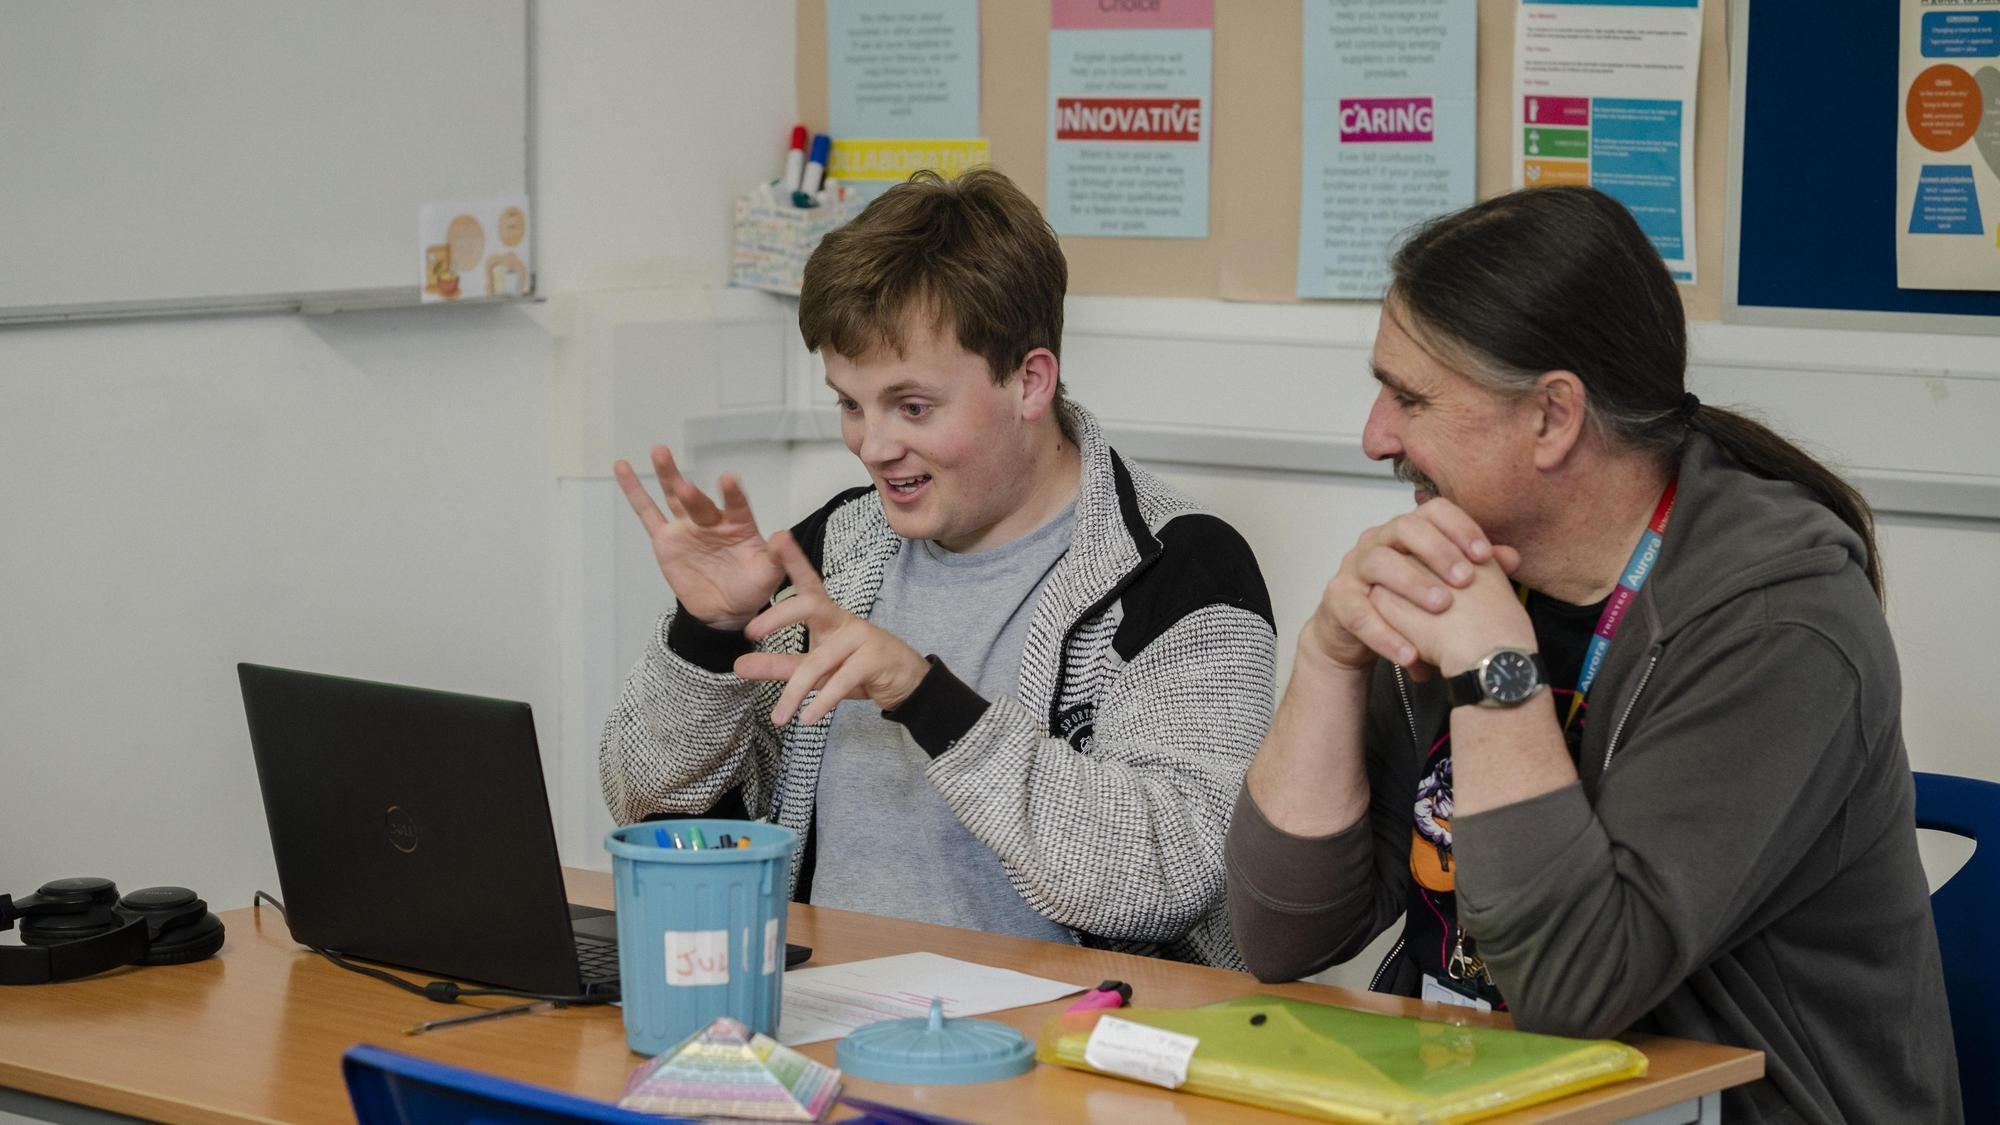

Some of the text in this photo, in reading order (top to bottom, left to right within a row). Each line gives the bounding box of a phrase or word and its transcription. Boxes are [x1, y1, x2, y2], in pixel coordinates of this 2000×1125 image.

[1056, 102, 1200, 133] INNOVATIVE
[1340, 103, 1432, 133] CARING
[1581, 640, 1607, 692] Aurora
[1602, 591, 1628, 635] TRUSTED
[1628, 538, 1661, 587] Aurora
